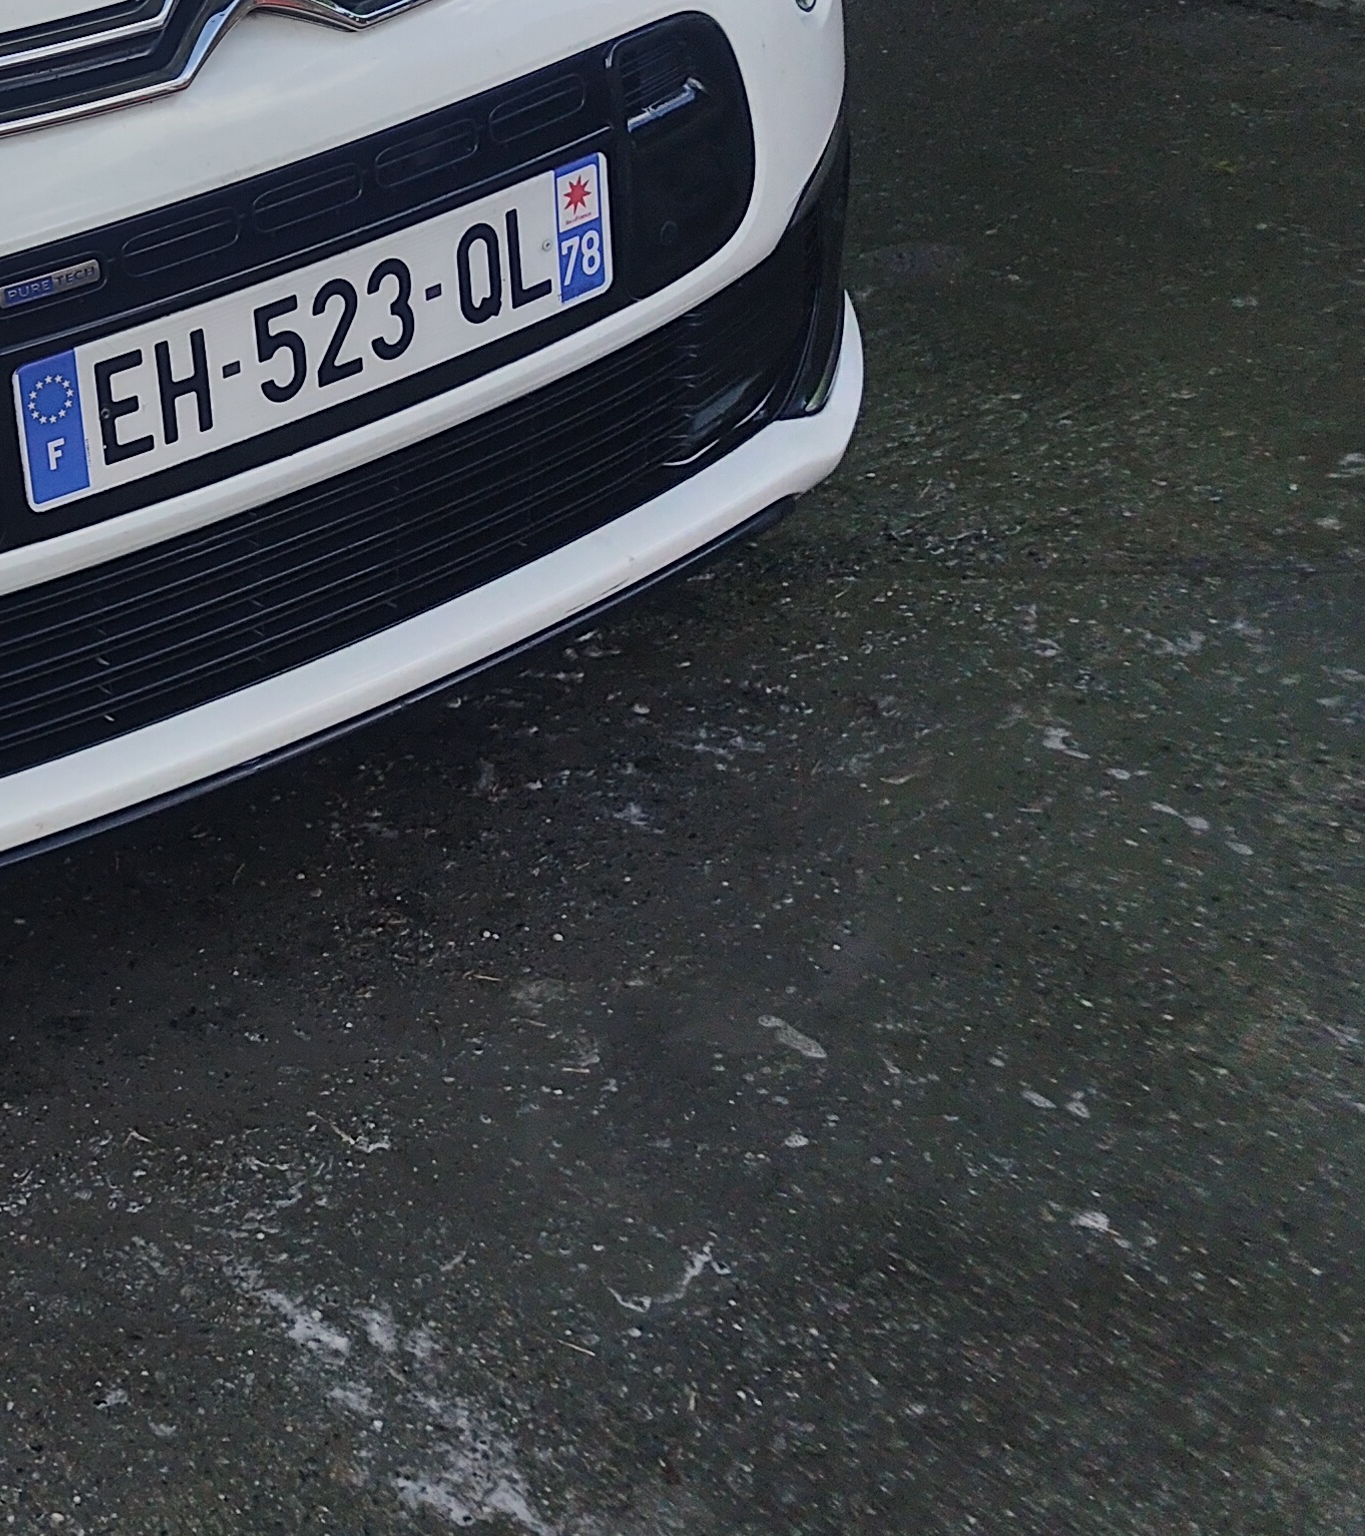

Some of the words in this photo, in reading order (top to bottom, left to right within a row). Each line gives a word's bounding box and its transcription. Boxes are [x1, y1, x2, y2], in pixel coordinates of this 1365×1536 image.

[561, 229, 601, 286] 78
[7, 280, 50, 298] PURE
[56, 266, 95, 285] TECH
[93, 209, 554, 466] EH-523-QL
[48, 437, 65, 471] F
